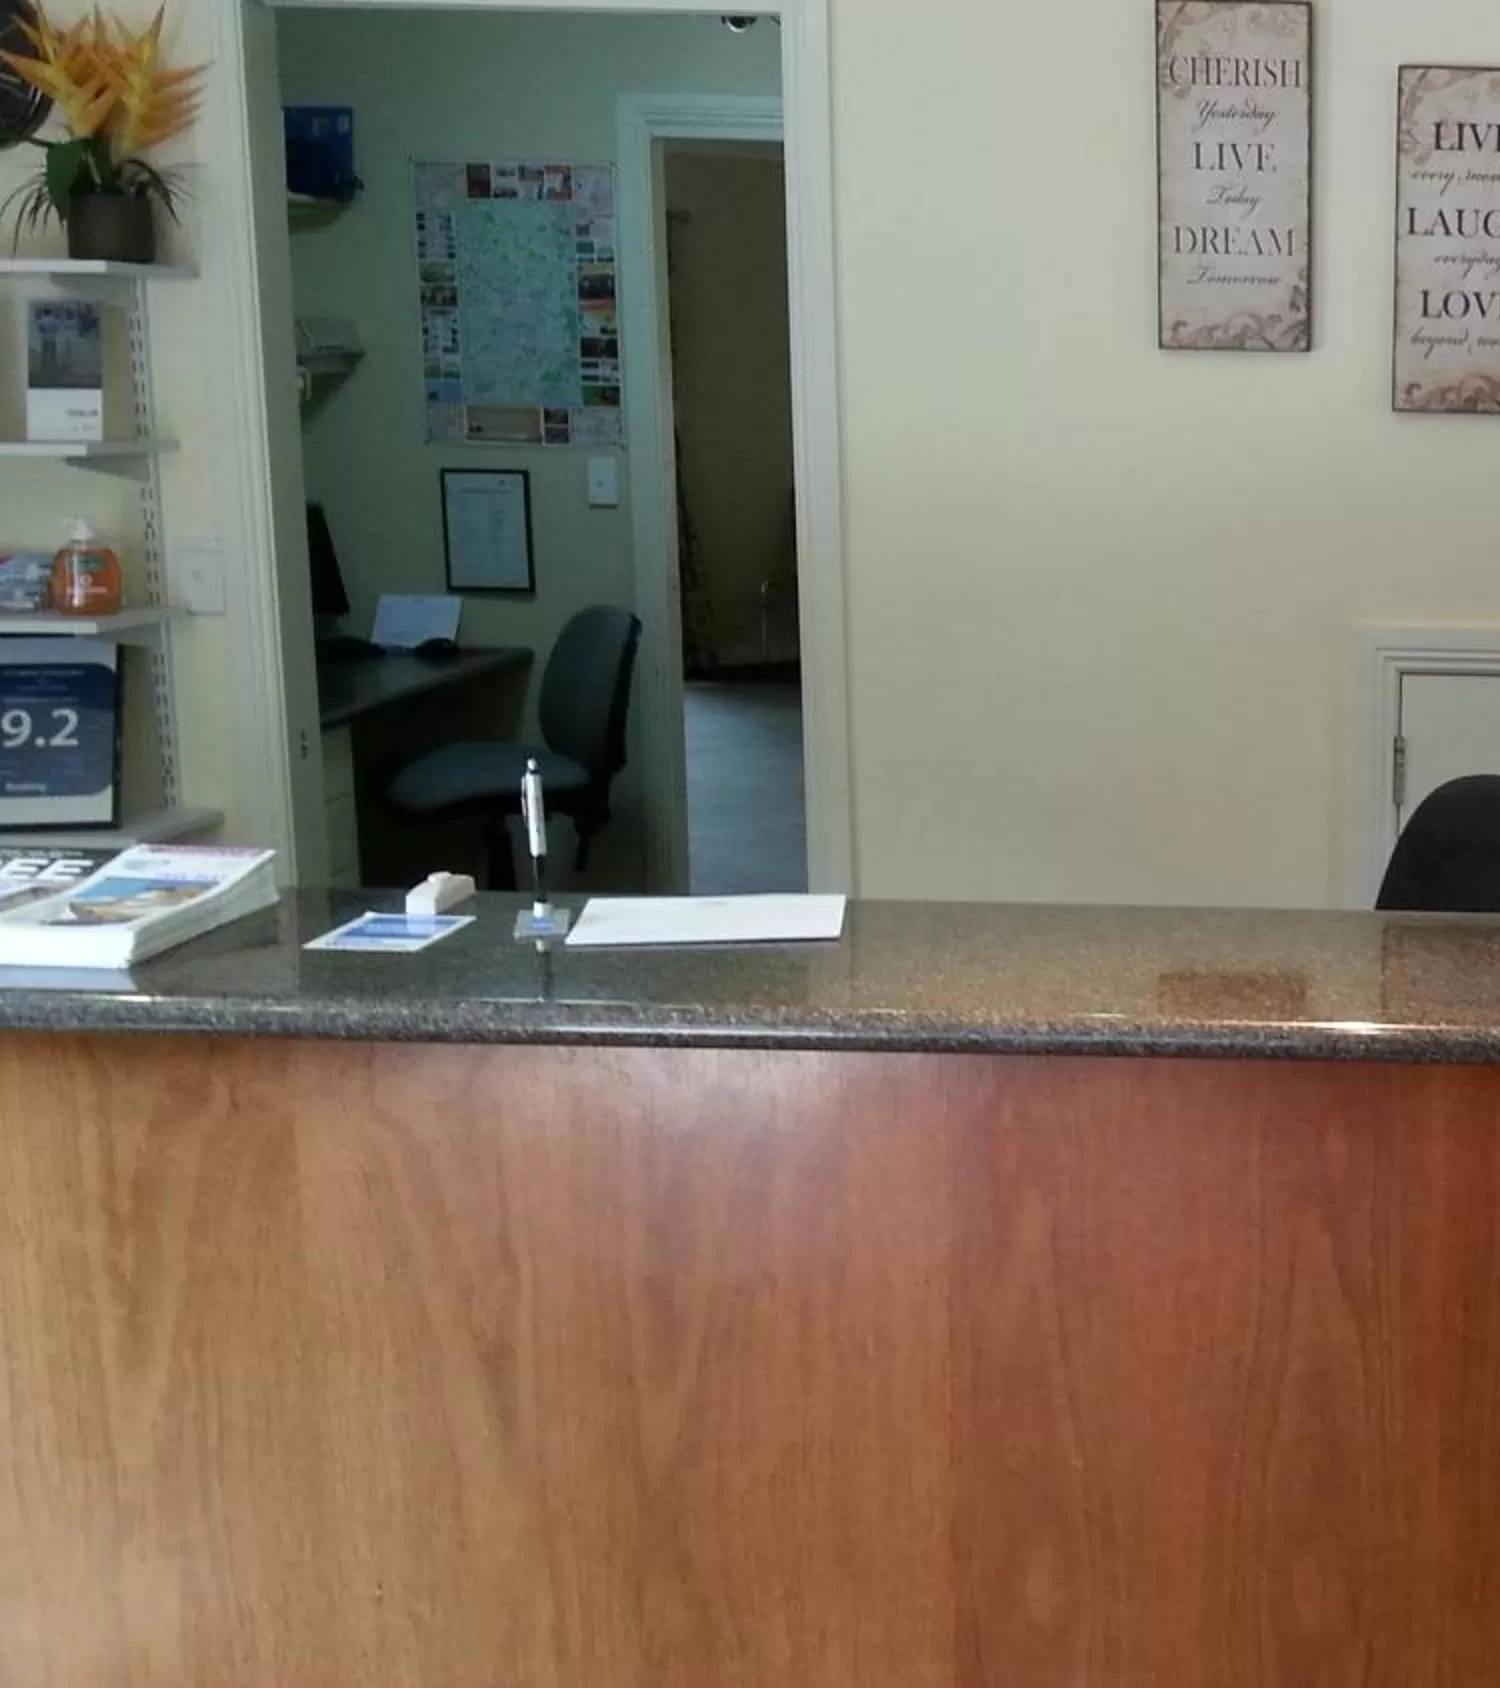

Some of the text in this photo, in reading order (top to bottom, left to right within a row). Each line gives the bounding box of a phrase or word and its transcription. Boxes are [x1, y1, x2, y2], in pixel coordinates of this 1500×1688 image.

[1168, 55, 1302, 89] CHERISH
[1195, 99, 1278, 132] Yesterday
[1192, 141, 1278, 173] LIVE
[1409, 170, 1454, 196] every
[1206, 185, 1263, 217] Today
[1172, 226, 1295, 257] DREAM
[1186, 265, 1283, 286] Tomorrow
[1410, 329, 1470, 360] beyond
[1, 707, 80, 748] 9.2
[0, 858, 95, 881] EE
